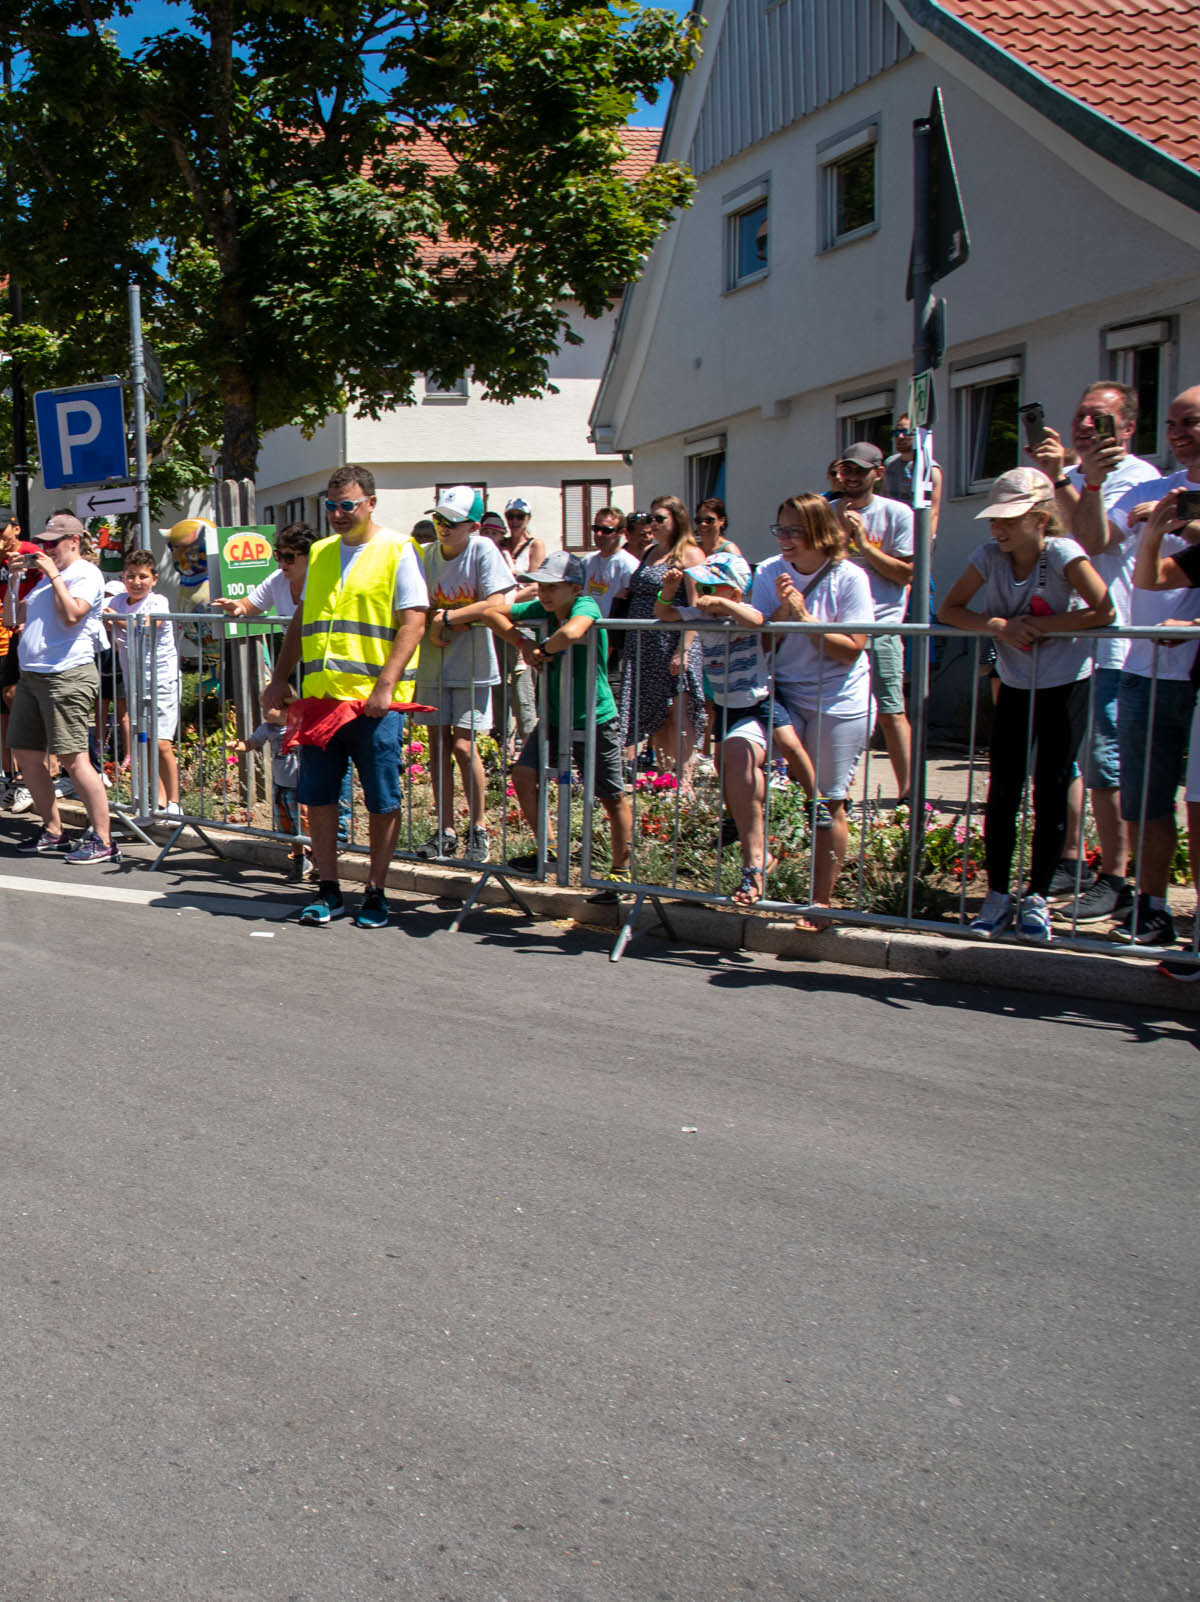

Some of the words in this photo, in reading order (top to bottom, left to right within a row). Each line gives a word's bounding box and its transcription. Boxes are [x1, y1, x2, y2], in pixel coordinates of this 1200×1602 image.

[56, 400, 102, 475] P
[230, 541, 265, 561] CAP
[227, 583, 245, 596] 100
